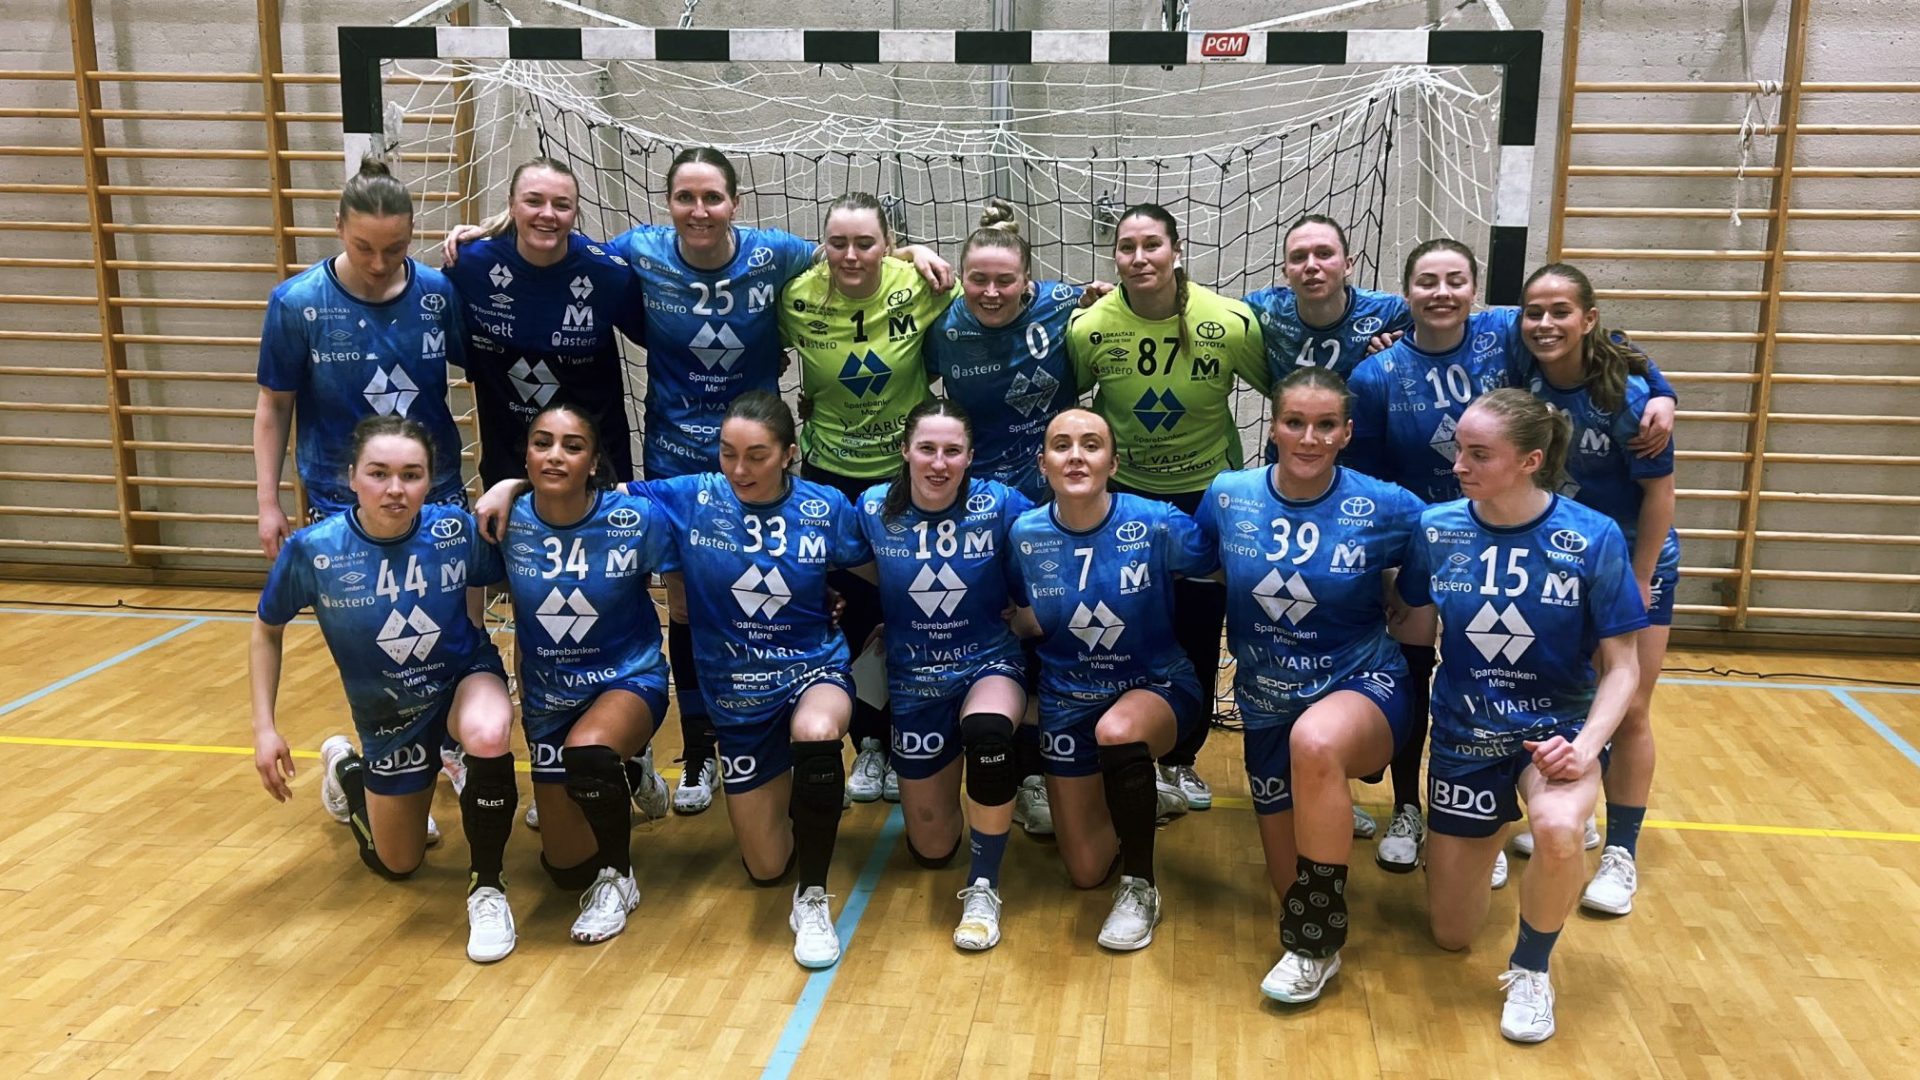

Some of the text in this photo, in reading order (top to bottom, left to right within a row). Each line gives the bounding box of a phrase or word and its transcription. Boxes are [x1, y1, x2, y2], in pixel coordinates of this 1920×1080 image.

[1205, 37, 1243, 52] PGM
[748, 264, 776, 277] TOYOTA
[690, 278, 734, 316] 25
[562, 304, 593, 326] M
[650, 299, 687, 314] astero
[850, 310, 868, 344] 1
[888, 314, 918, 337] M
[1026, 322, 1050, 360] 0
[1194, 340, 1226, 348] TOYOTA
[1137, 337, 1182, 376] 87
[1295, 337, 1341, 370] 42
[962, 364, 1000, 376] astero
[1191, 357, 1220, 376] M
[1426, 364, 1472, 409] 10
[680, 424, 720, 435] spor
[863, 414, 906, 433] VARIG
[1580, 428, 1610, 451] M
[799, 519, 830, 528] TOYOTA
[965, 512, 998, 522] TOYOTA
[1337, 518, 1374, 528] TOYOTA
[606, 530, 642, 538] TOYOTA
[744, 515, 788, 557] 33
[912, 520, 958, 560] 18
[964, 530, 994, 552] M
[1266, 518, 1320, 566] 39
[1439, 530, 1477, 538] LOKALTAXI
[434, 536, 466, 550] TOYOTA
[699, 536, 736, 552] astero
[798, 536, 826, 558] M
[1116, 541, 1150, 552] TOYOTA
[542, 536, 588, 580] 34
[606, 548, 638, 572] M
[1331, 544, 1366, 567] M
[1546, 550, 1585, 564] TOYOTA
[441, 560, 466, 587] M
[1074, 547, 1094, 592] 7
[1120, 562, 1150, 589] M
[1480, 546, 1529, 598] 15
[376, 554, 428, 604] 44
[1438, 579, 1472, 592] astero
[1542, 573, 1580, 600] M
[332, 596, 375, 608] astero
[912, 619, 968, 630] Sparebanken
[748, 631, 772, 640] Møre
[929, 631, 952, 640] Møre
[537, 646, 600, 658] Sparebanken
[932, 643, 978, 662] VARIG
[1275, 656, 1332, 670] VARIG
[563, 668, 617, 688] VARIG
[732, 670, 783, 682] sport
[1470, 668, 1536, 680] Sparebanken
[1256, 676, 1304, 690] sport
[1489, 679, 1515, 688] Møre
[1494, 698, 1552, 715] VARIG
[980, 754, 1006, 764] SELECT
[478, 798, 504, 806] SELECT
[1435, 780, 1496, 814] BDO
